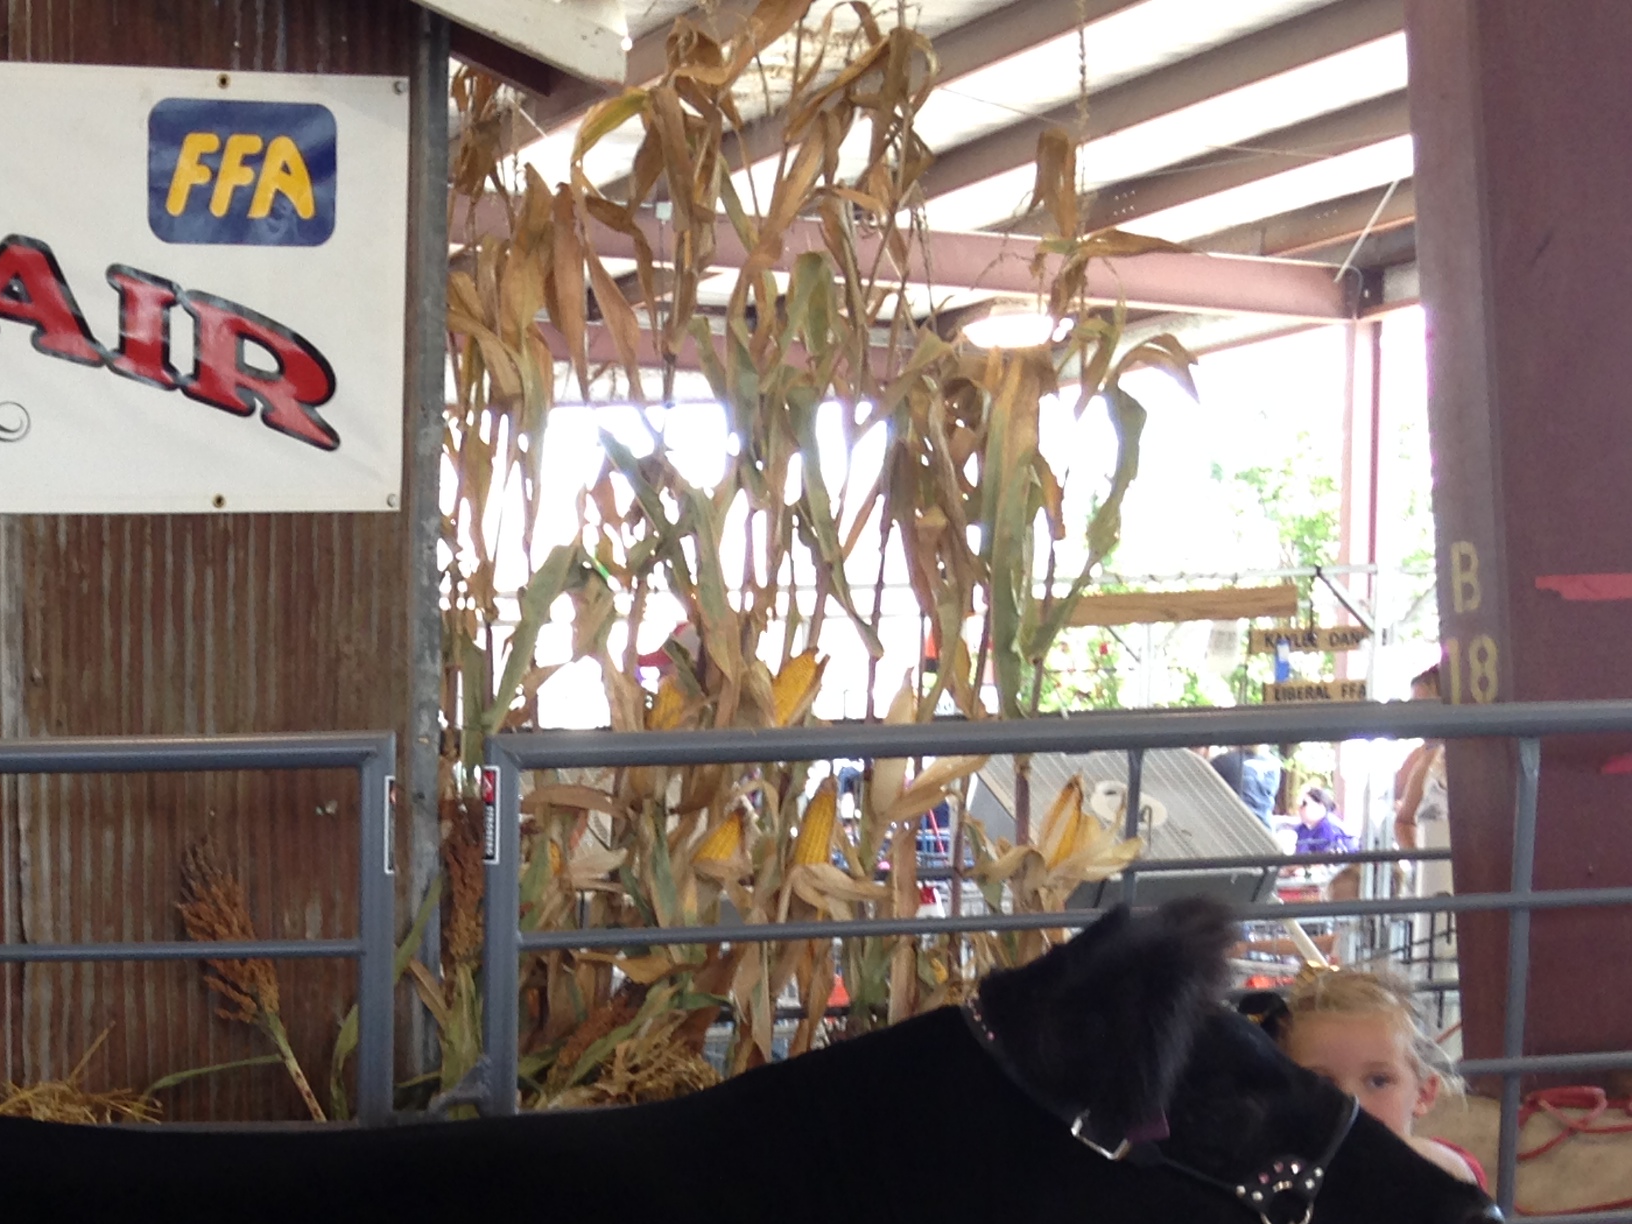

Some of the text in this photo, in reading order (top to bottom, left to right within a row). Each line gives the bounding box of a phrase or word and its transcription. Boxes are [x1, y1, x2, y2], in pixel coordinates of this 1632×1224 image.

[165, 132, 316, 220] FFA
[1451, 541, 1481, 613] B
[1446, 634, 1499, 704] 18
